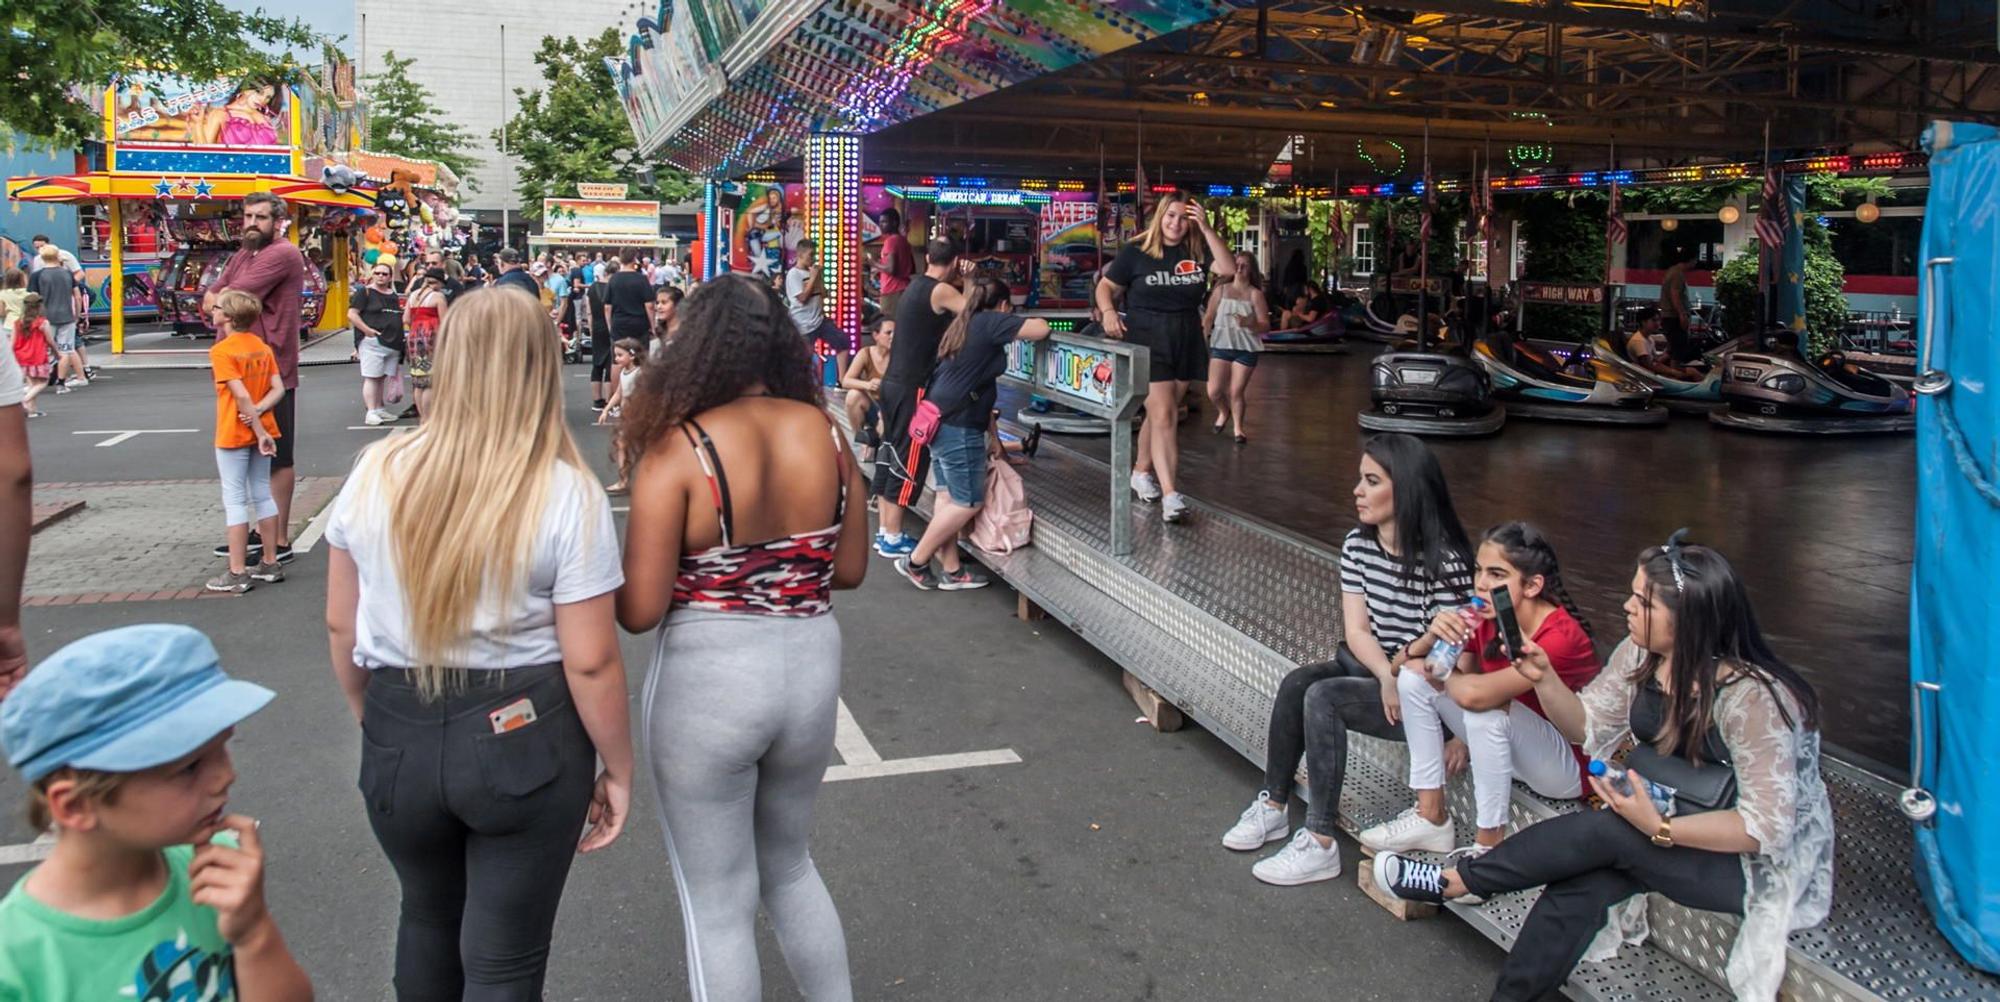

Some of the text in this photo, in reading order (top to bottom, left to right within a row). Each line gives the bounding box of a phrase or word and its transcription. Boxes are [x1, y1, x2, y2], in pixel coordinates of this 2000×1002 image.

[939, 191, 1021, 204] AMERICAN DREAM
[1542, 286, 1563, 300] HIGH
[1567, 286, 1589, 301] WAY
